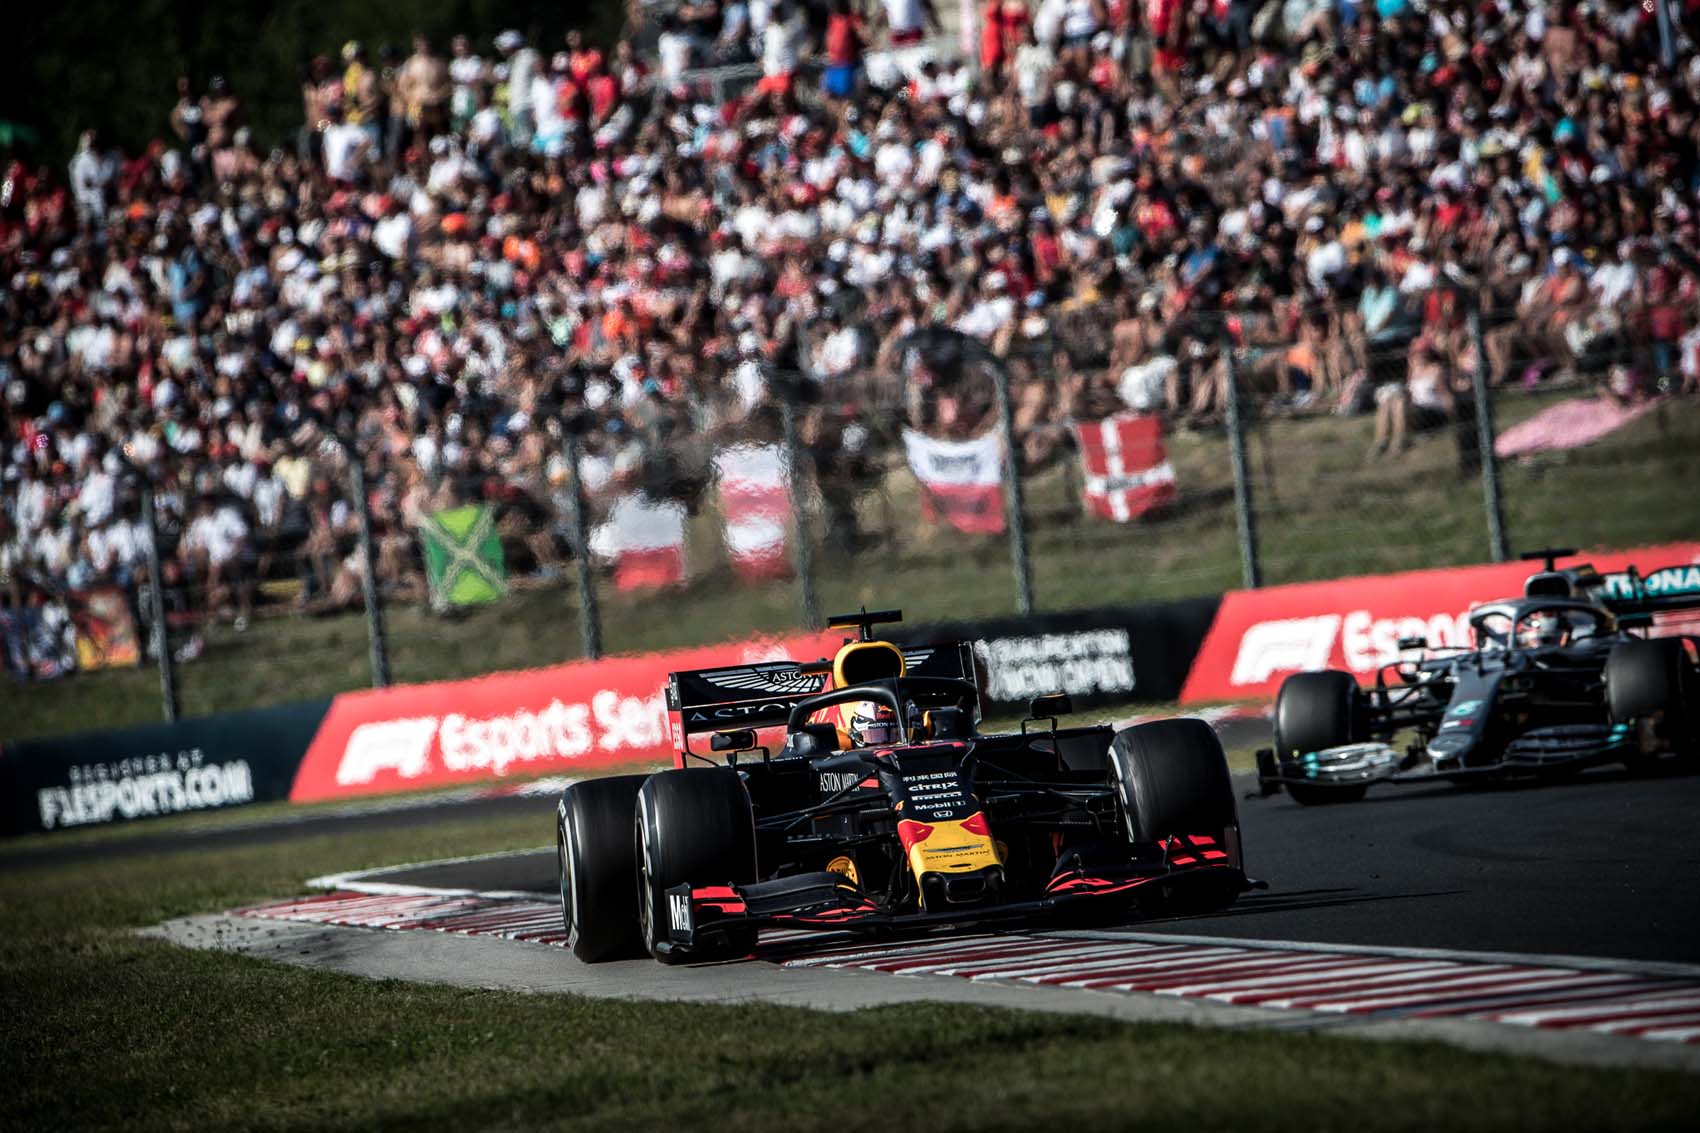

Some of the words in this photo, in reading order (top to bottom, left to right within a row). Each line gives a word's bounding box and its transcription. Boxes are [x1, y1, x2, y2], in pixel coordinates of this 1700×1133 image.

[439, 698, 593, 775] Esports
[820, 772, 842, 792] ASTON
[914, 802, 951, 811] Mobil
